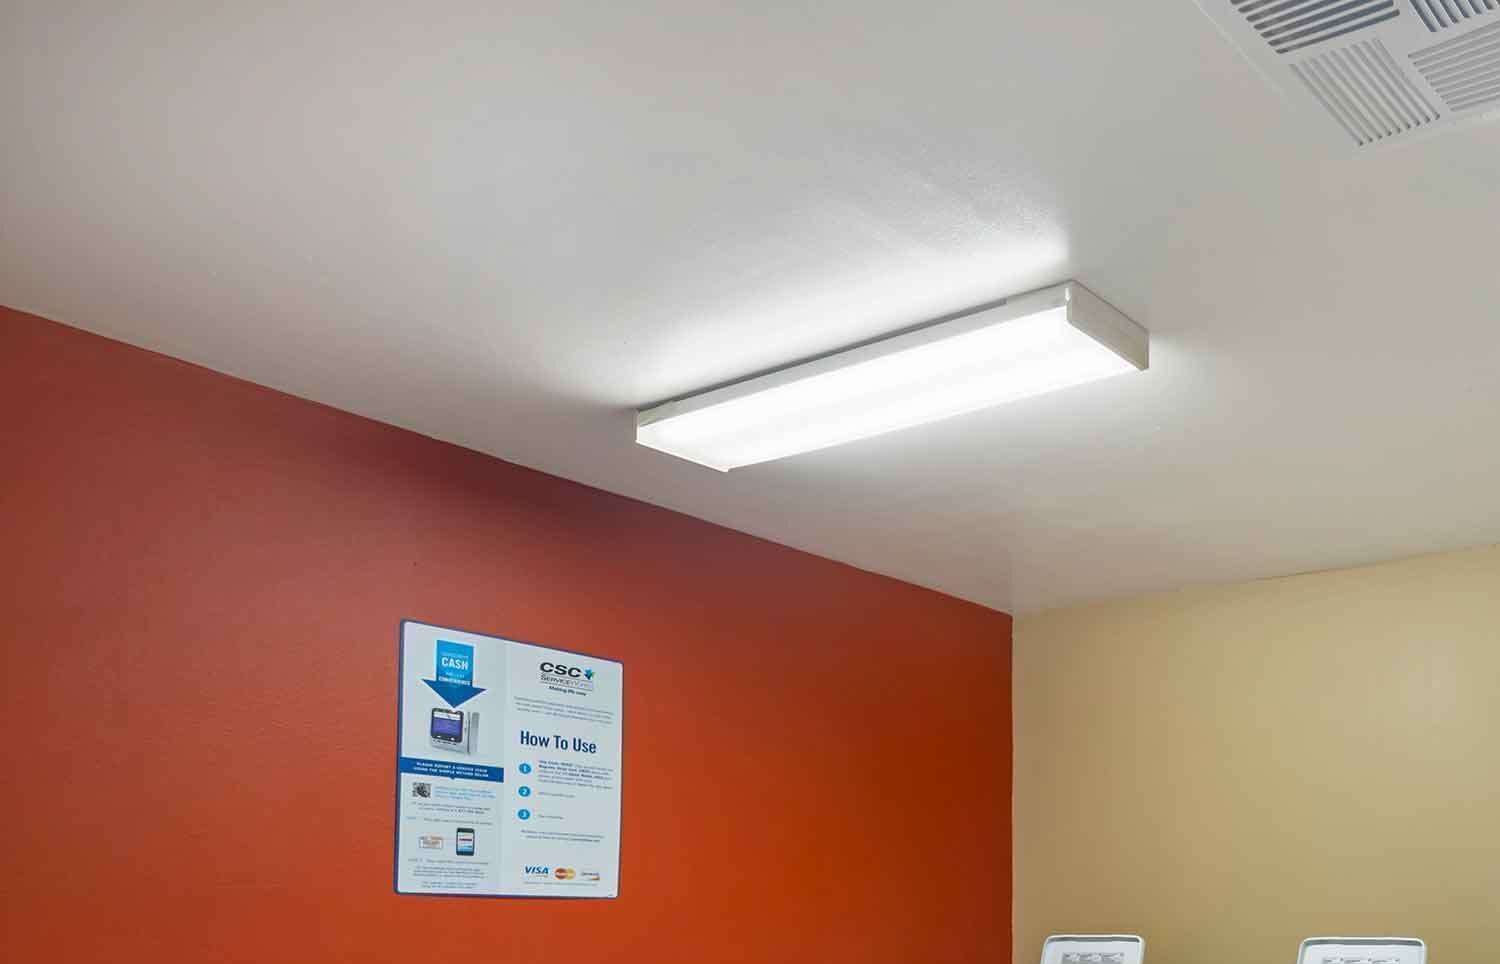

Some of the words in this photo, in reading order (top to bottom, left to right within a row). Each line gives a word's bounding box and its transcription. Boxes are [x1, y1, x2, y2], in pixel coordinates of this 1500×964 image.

[441, 657, 469, 670] CASH
[540, 662, 581, 678] CSC
[520, 730, 550, 748] How
[553, 735, 568, 750] To
[573, 737, 597, 754] Use
[525, 866, 549, 874] VISA
